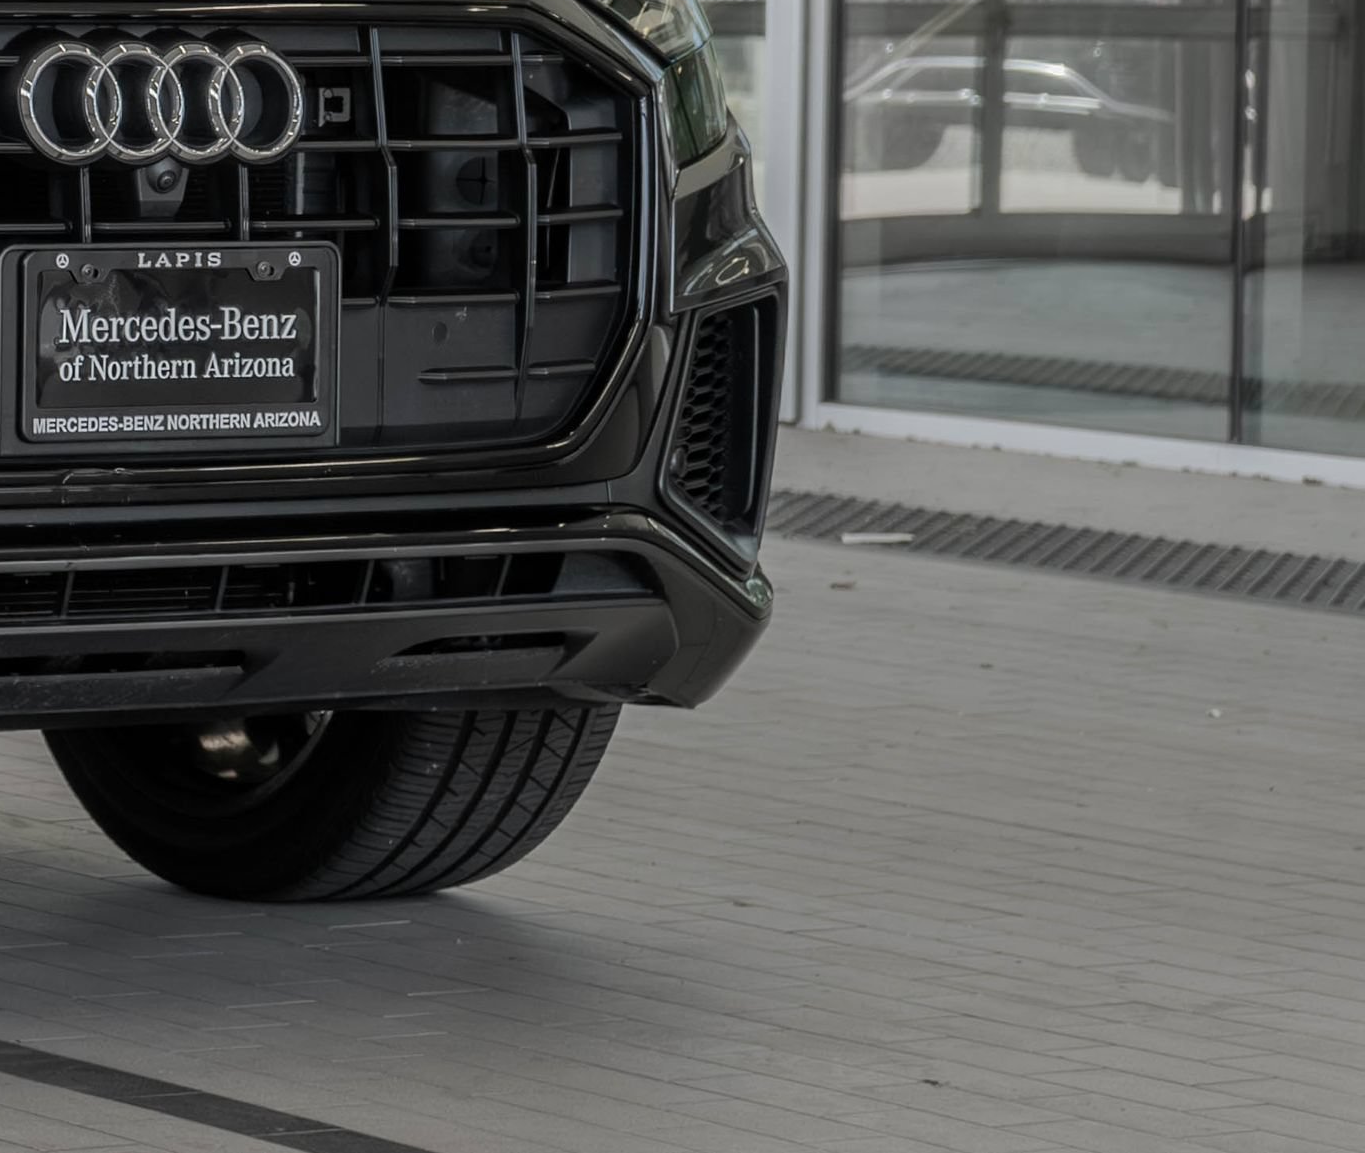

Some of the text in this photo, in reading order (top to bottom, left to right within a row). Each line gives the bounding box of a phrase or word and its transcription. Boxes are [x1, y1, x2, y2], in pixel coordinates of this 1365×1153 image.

[137, 251, 222, 268] LAPIS
[58, 306, 297, 343] Mercedes-Benz
[59, 352, 295, 382] of Northern Arizona
[33, 410, 322, 434] MERCEDES-BENZ NORTHERN ARIZONA
